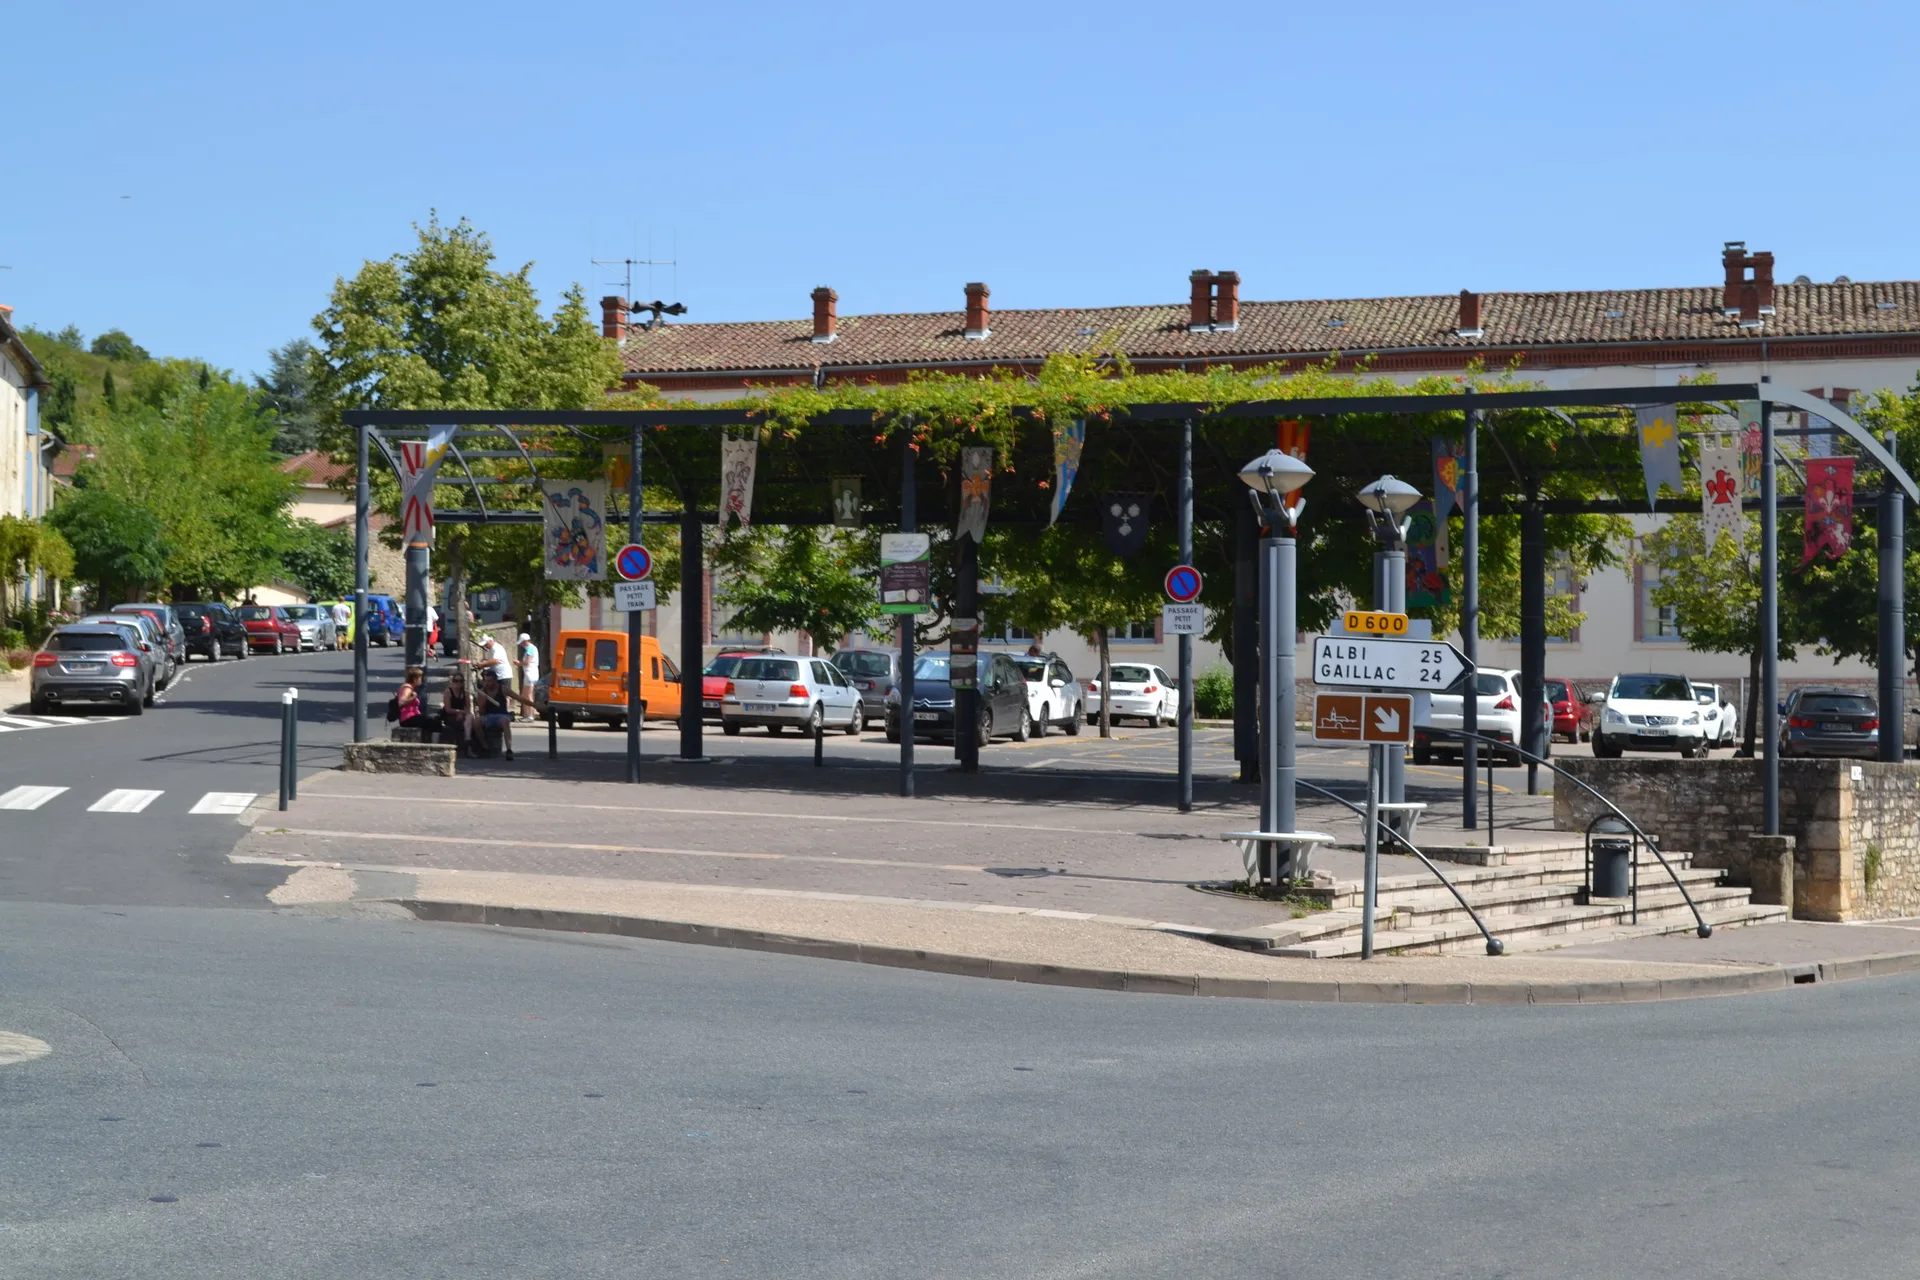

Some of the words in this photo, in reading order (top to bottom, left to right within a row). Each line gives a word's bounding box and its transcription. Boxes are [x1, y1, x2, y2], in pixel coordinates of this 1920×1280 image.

[619, 584, 650, 592] PASSAGE
[1322, 645, 1366, 660] ALBI
[1420, 650, 1442, 663] 25
[1321, 664, 1396, 680] GAILLAC
[1420, 669, 1442, 682] 24
